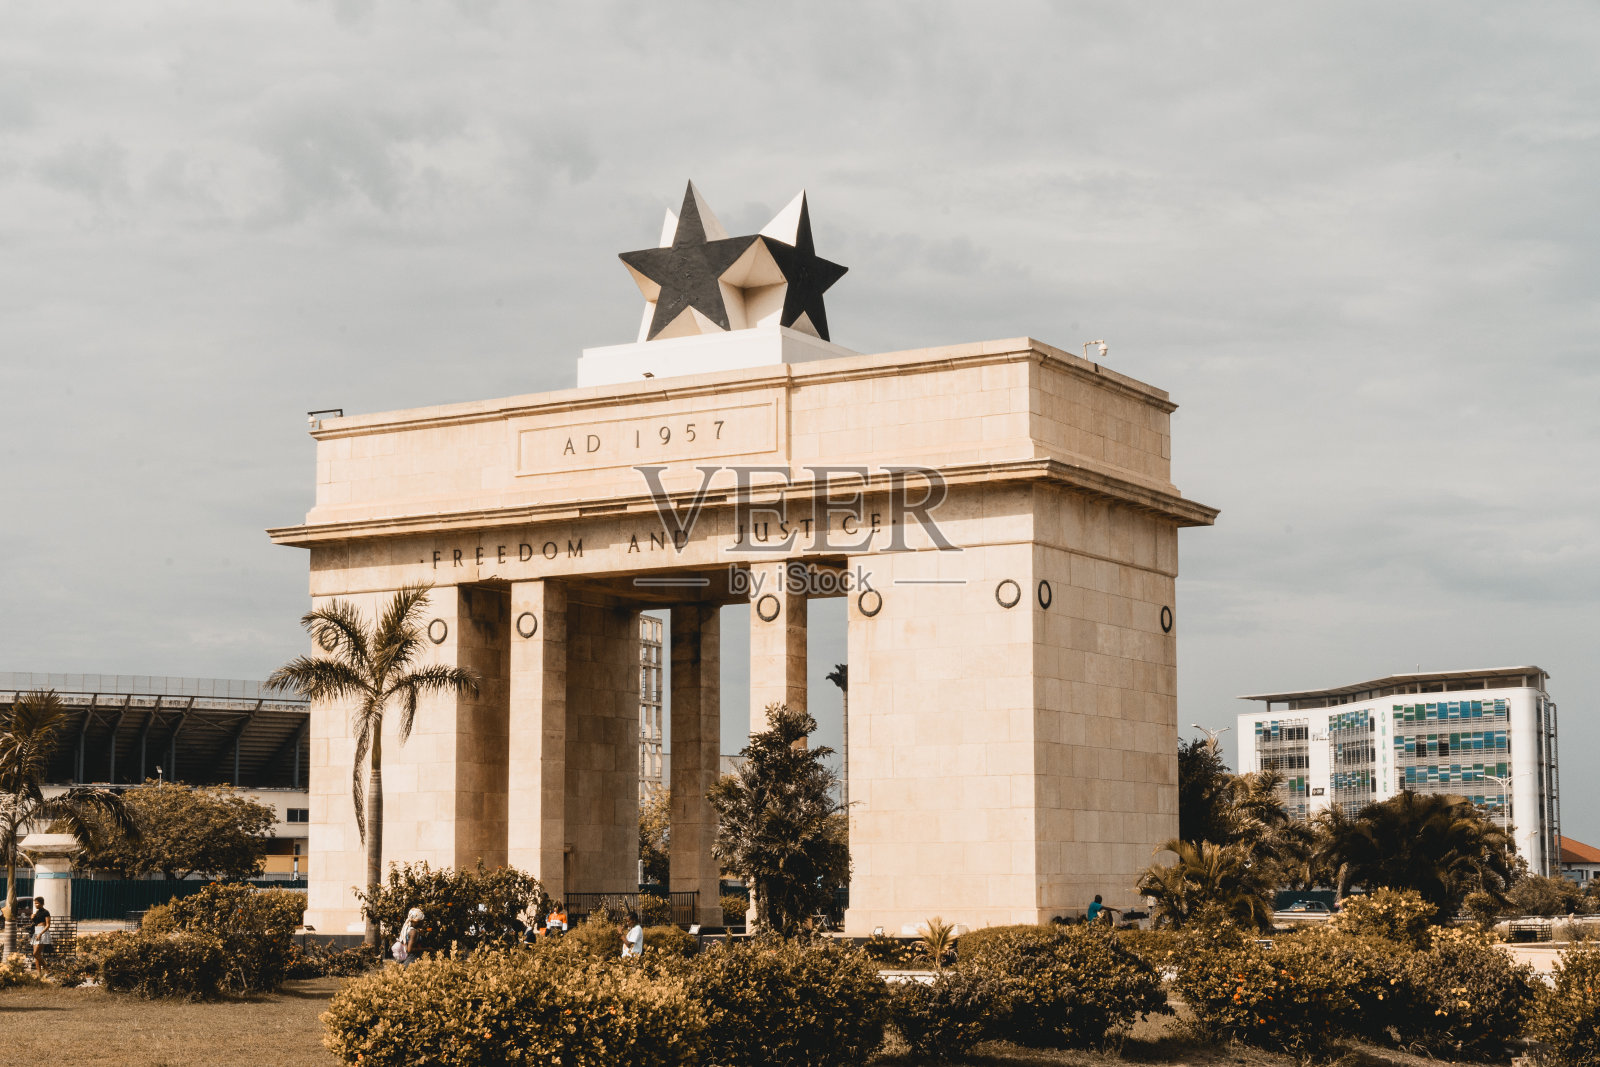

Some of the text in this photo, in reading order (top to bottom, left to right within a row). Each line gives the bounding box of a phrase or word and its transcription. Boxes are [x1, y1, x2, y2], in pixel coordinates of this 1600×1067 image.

[563, 420, 724, 456] AD 1957
[627, 530, 689, 554] AND
